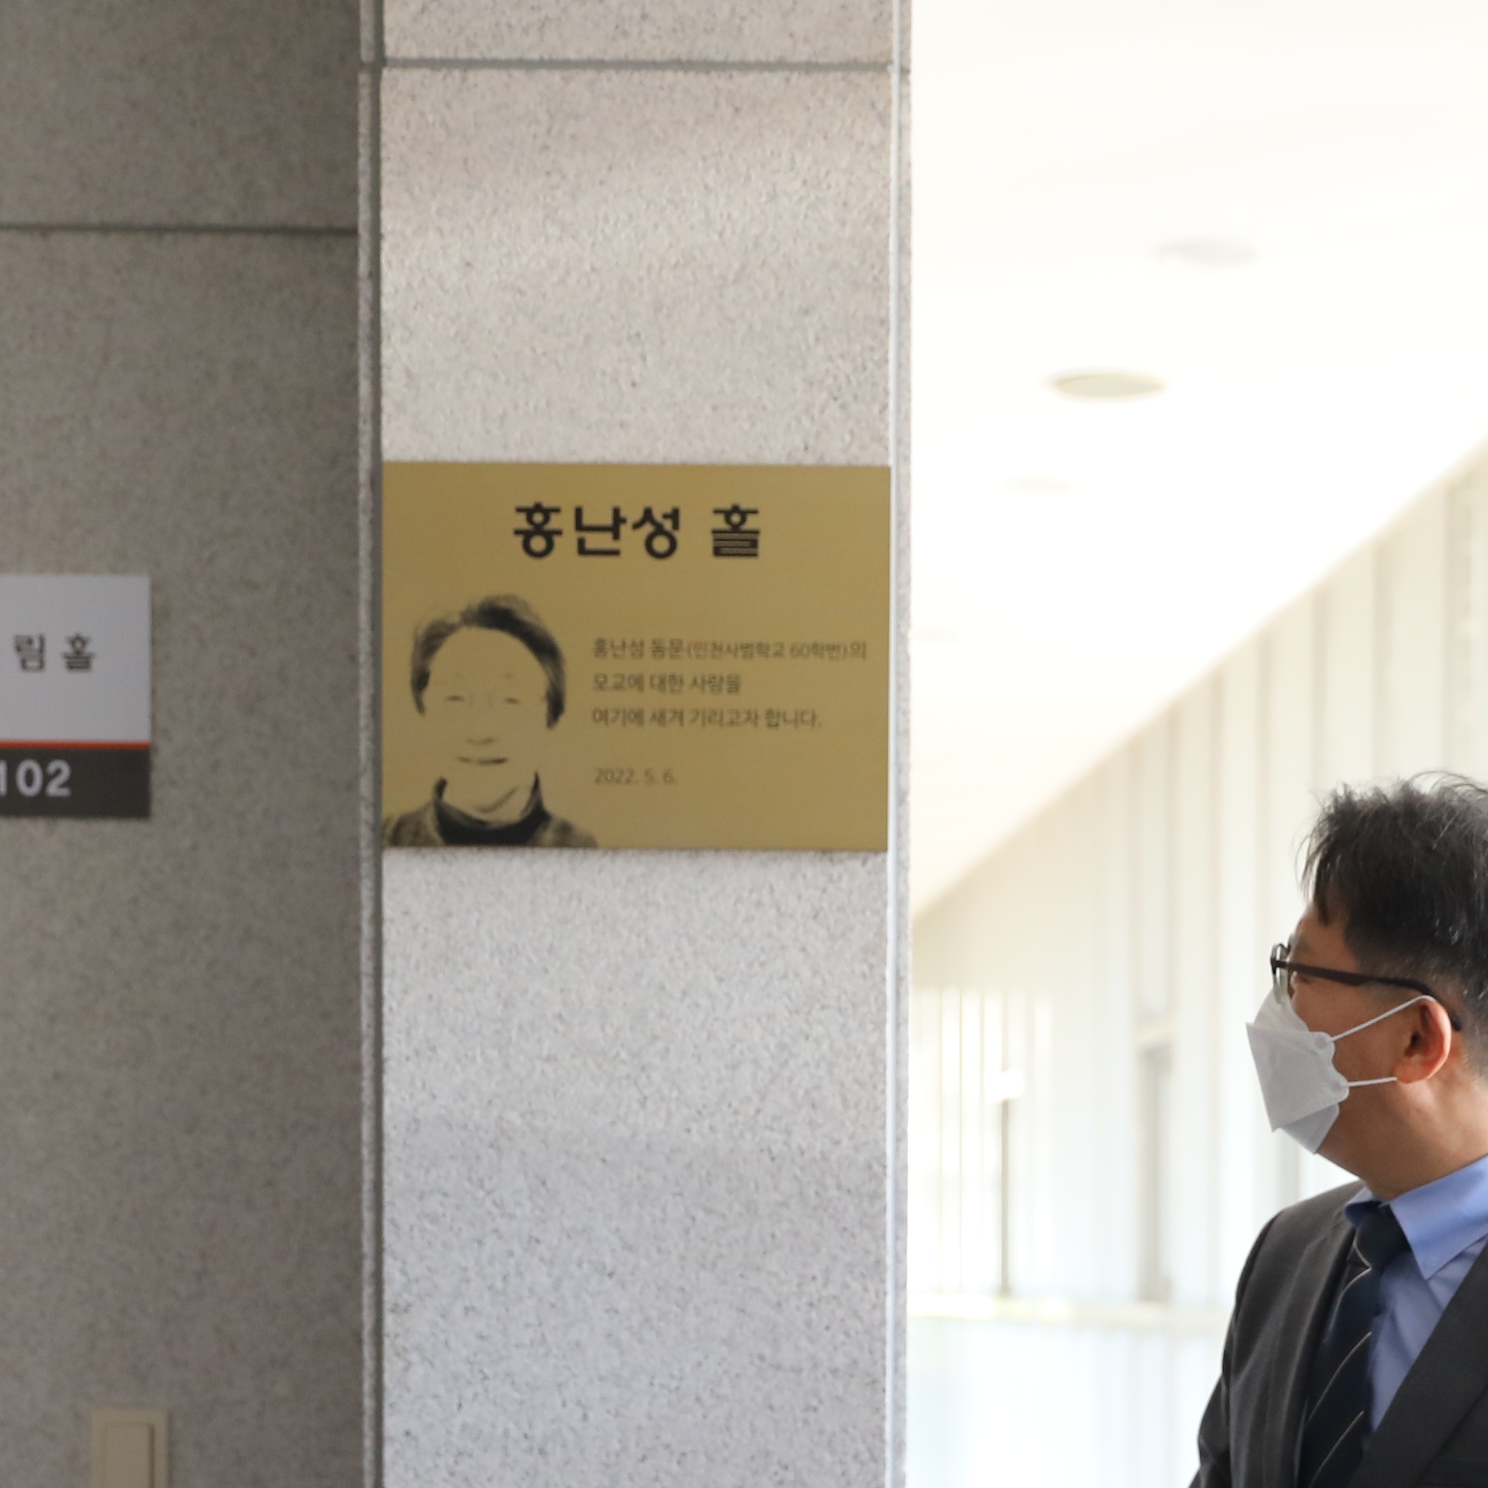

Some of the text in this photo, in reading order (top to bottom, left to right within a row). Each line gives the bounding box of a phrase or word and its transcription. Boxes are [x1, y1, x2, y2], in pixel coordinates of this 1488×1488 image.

[514, 502, 761, 559] 홍난성 홀
[593, 637, 645, 660] 홍난성
[593, 672, 741, 695] 모교에 대한 사랑을
[592, 707, 645, 728] 여기에
[689, 708, 760, 729] 기리고자
[594, 766, 640, 786] 2022.
